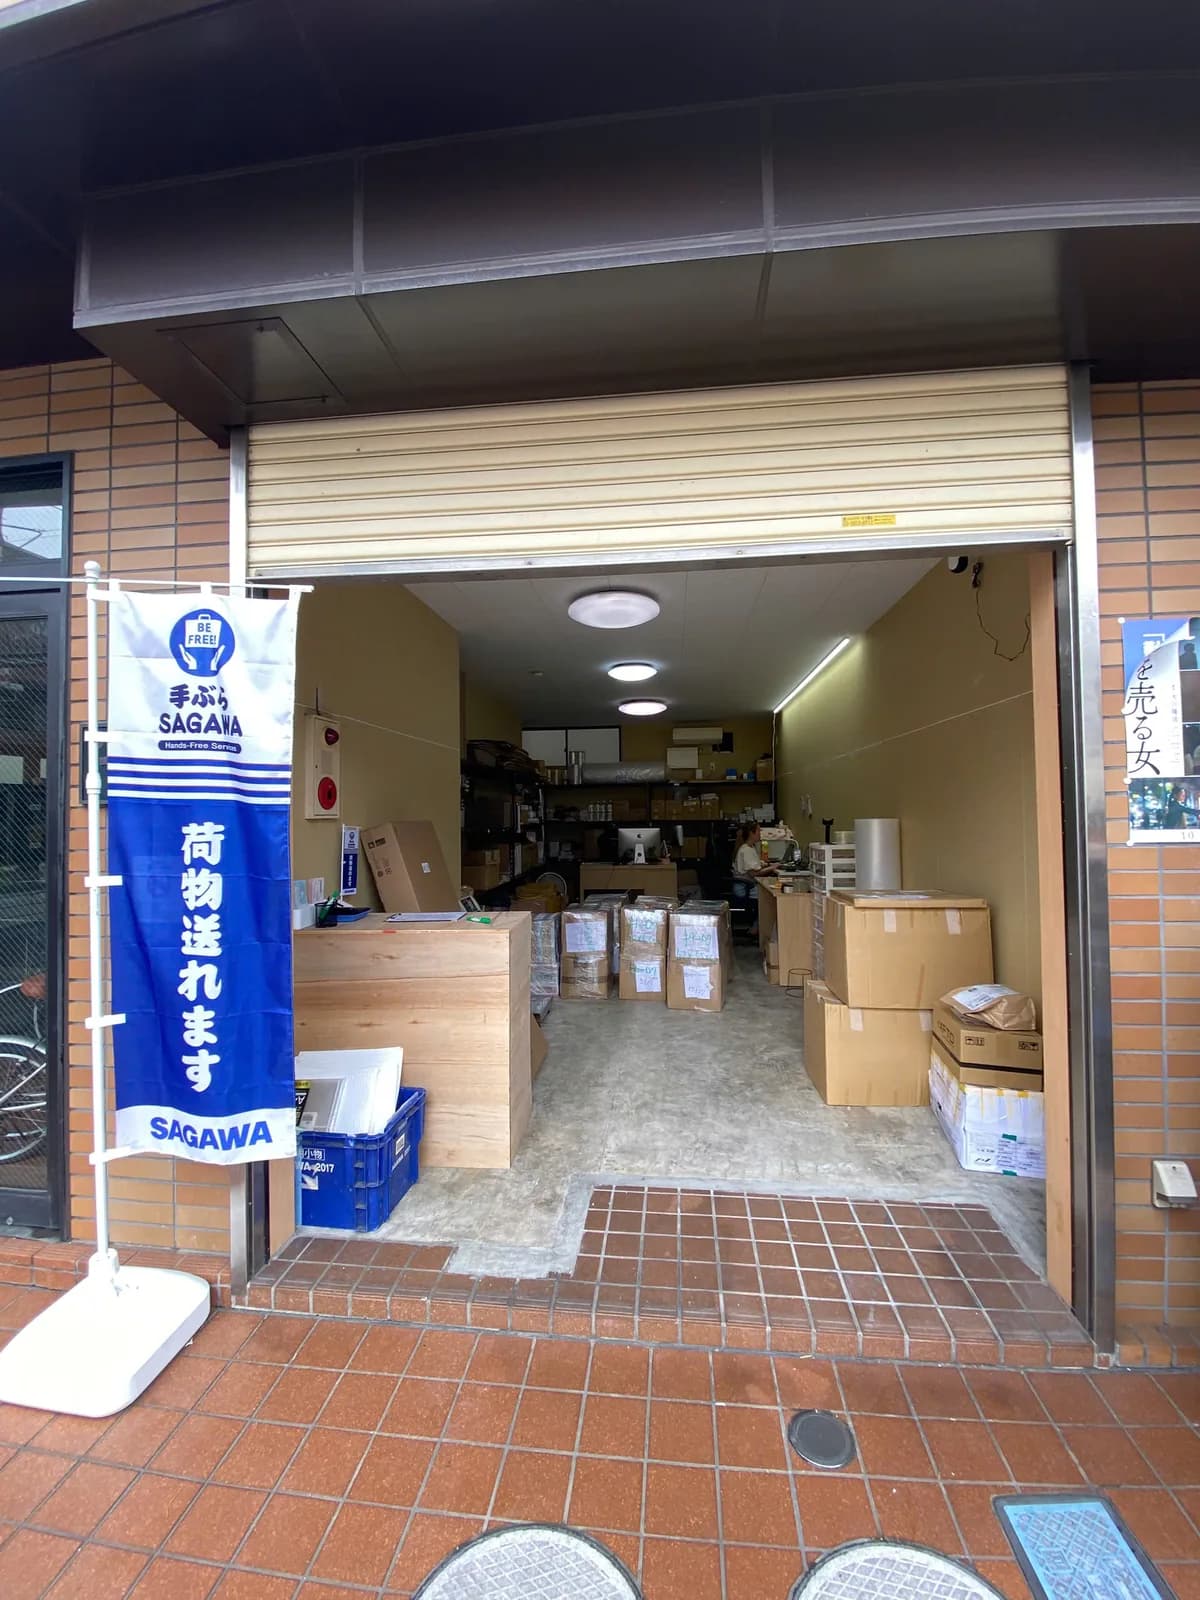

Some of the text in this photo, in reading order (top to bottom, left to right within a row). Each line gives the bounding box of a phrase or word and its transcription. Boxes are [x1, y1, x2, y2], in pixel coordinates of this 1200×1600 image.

[188, 635, 217, 644] FREE!
[197, 622, 211, 632] BE
[169, 684, 228, 711] 手ぶら
[159, 712, 243, 737] SAGAWA
[1124, 659, 1160, 775] を売る女
[177, 822, 225, 1092] 荷物送れます
[150, 1117, 273, 1151] SAGAWA
[315, 1163, 334, 1173] 2017
